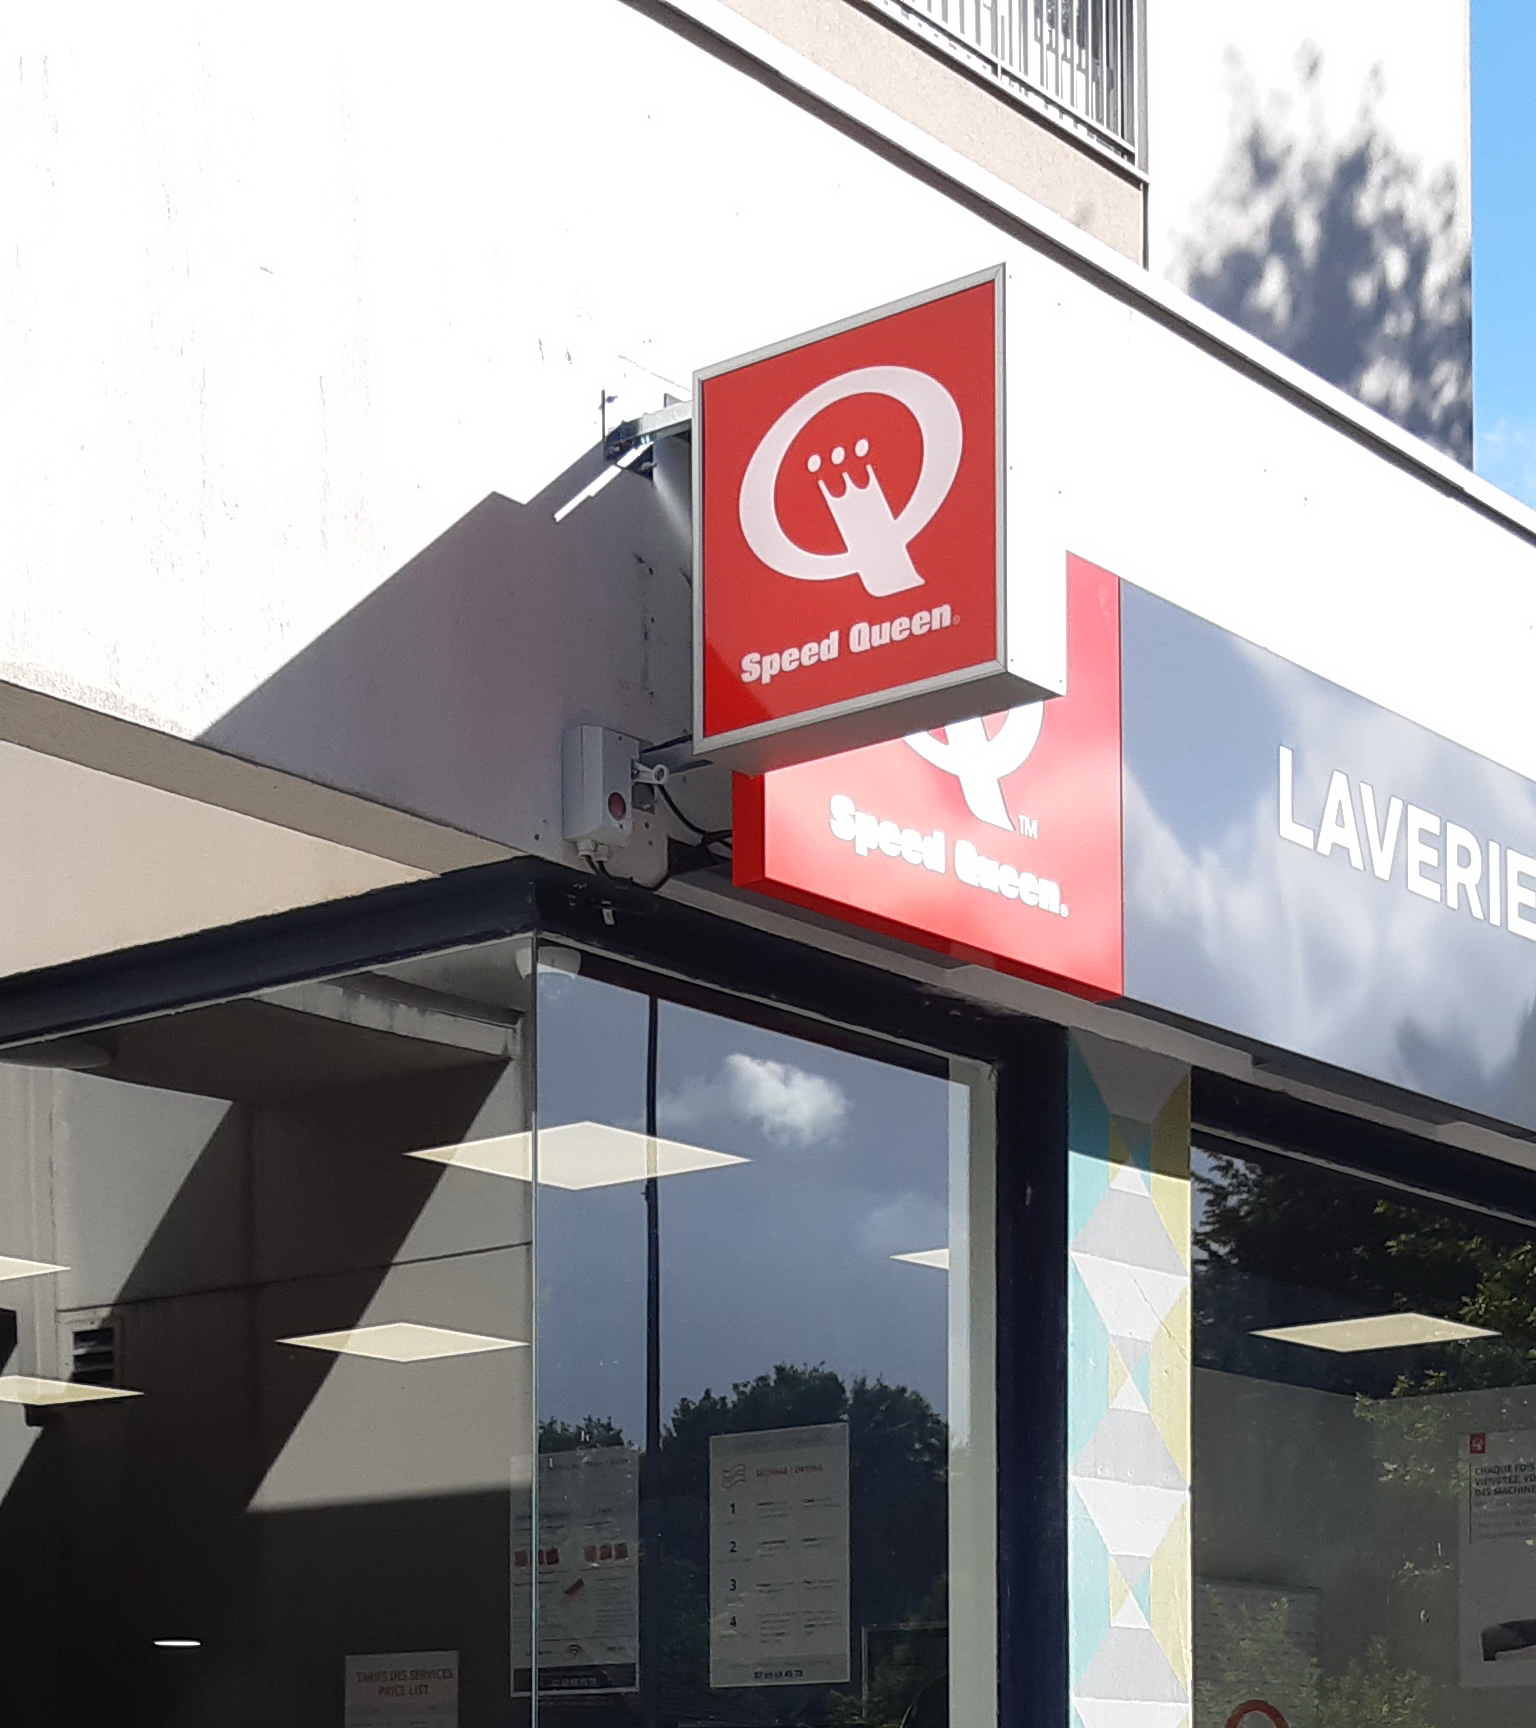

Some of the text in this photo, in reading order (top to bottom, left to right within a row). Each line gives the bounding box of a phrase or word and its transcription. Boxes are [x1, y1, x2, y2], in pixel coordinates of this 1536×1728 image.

[740, 603, 952, 685] Speed Queen
[830, 794, 1062, 915] Speed Queen
[729, 1503, 737, 1515] 1
[729, 1541, 737, 1553] 2
[729, 1579, 737, 1591] 3
[729, 1616, 737, 1628] 4
[390, 1669, 408, 1682] DES
[410, 1668, 453, 1681] SERVICES
[408, 1684, 429, 1696] LIST
